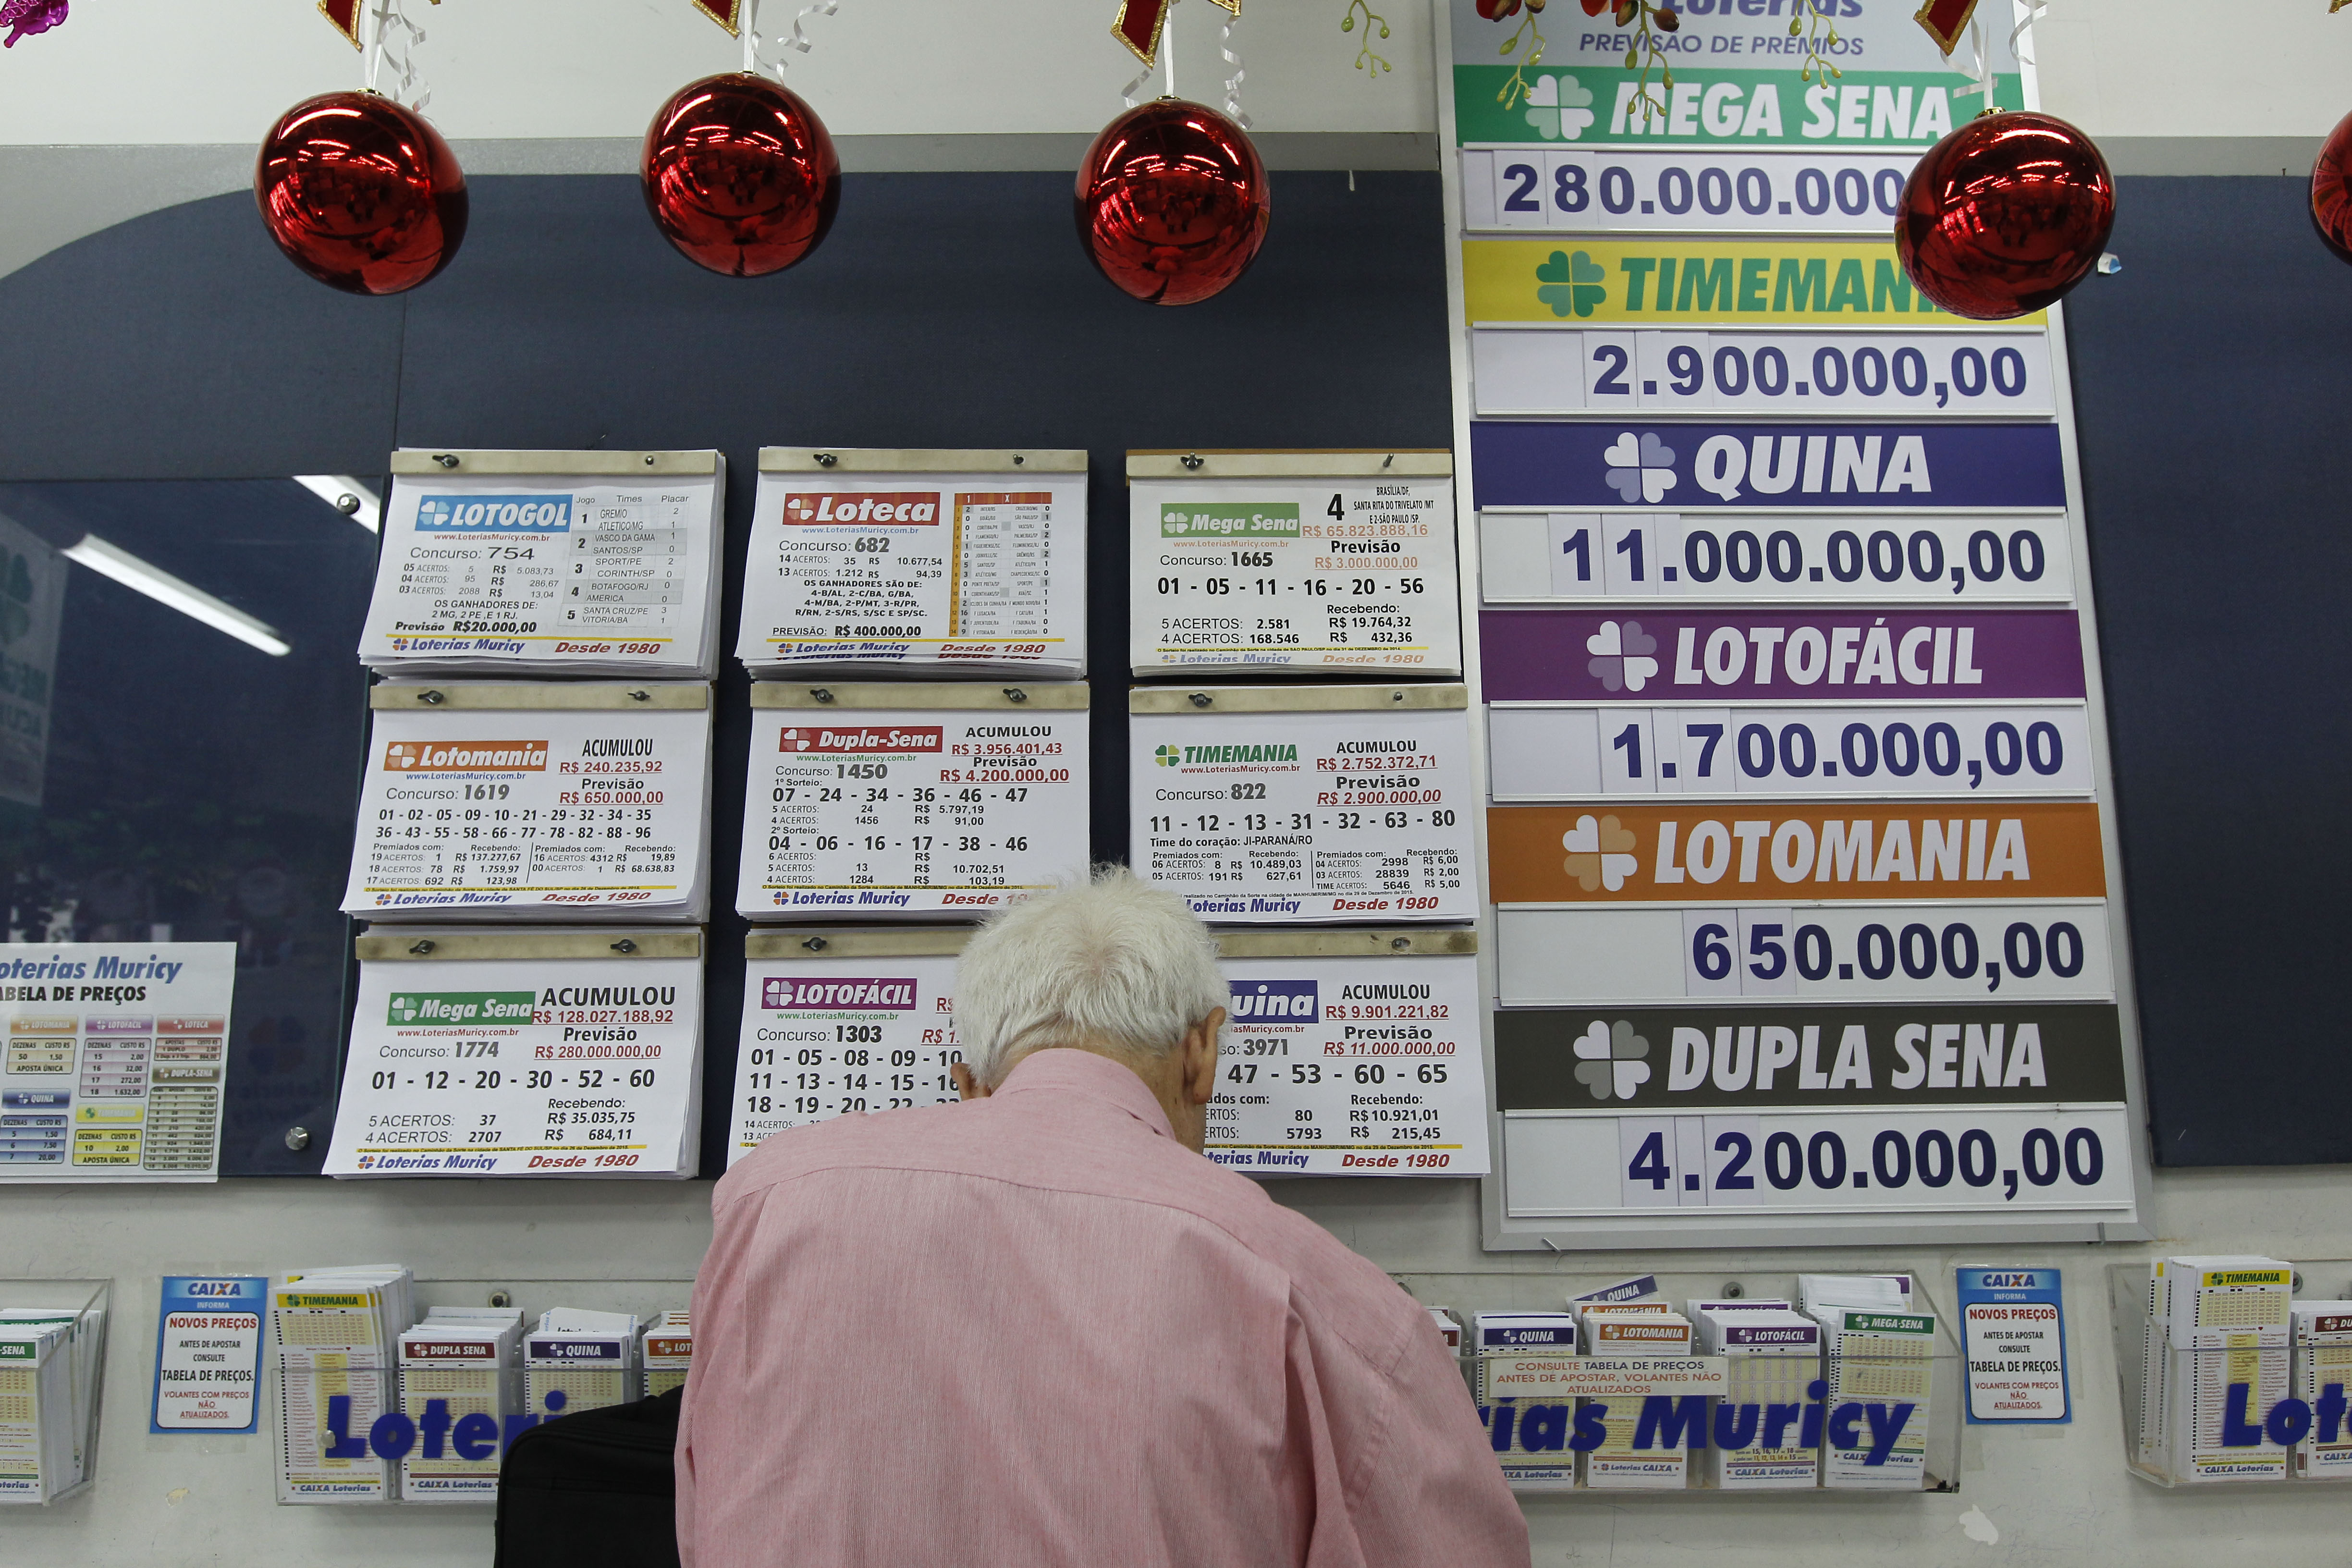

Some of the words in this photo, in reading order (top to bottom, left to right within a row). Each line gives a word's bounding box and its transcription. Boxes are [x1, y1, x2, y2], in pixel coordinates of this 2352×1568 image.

[1580, 30, 1702, 54] PREVISÃO
[1710, 36, 1743, 53] DE
[1609, 82, 1784, 136] MEGA
[1801, 85, 1951, 139] SENA
[1593, 345, 2026, 408] 2.900.000,00
[1695, 435, 1932, 502] QUINA
[451, 503, 567, 526] LOTOGOL
[600, 509, 627, 518] GREMIO
[816, 497, 935, 521] Loteca
[1191, 514, 1245, 533] Mega
[1251, 514, 1298, 530] Sena
[435, 534, 550, 542] www.LoteriasMuricy.com.br
[780, 540, 850, 551] Concurso:
[855, 538, 890, 552] 682
[1174, 540, 1288, 548] www.LoteriasMuricy.com.br
[1332, 539, 1400, 553] Previsão
[411, 548, 481, 558] Concurso:
[489, 547, 534, 560] 754
[1161, 555, 1226, 565] Concurso:
[1232, 552, 1273, 566] 1665
[1563, 528, 2045, 594] 11.000.000,00
[395, 622, 444, 630] Previsão
[453, 621, 537, 633] R$20.000,00
[773, 625, 827, 635] PREVISÃO:
[835, 625, 850, 635] R$
[854, 625, 921, 637] 400.000,00
[411, 638, 470, 650] Loterias
[473, 638, 526, 653] Muricy
[554, 642, 611, 653] Desde
[617, 642, 661, 654] 1980
[1674, 618, 1982, 685] LOTOFÁCIL
[966, 726, 1051, 737] ACUMULOU
[819, 730, 937, 749] Dupla-Sena
[1337, 740, 1416, 753] ACUMULOU
[582, 739, 652, 756] ACUMULOU
[1185, 745, 1297, 763] TIMEMANIA
[420, 743, 547, 767] Lotomania
[974, 756, 1037, 767] Previsão
[1614, 722, 2063, 790] 1.700.000,00
[1181, 764, 1300, 773] www.LoteriasMuricy.com.br
[582, 779, 644, 789] Previsão
[1337, 775, 1420, 788] Previsão
[387, 788, 458, 799] Concurso:
[466, 784, 509, 800] 1619
[560, 792, 579, 804] R$
[585, 791, 663, 804] 650.000,00
[1156, 789, 1227, 800] Concurso:
[1231, 784, 1265, 799] 822
[1151, 838, 1175, 846] Time
[1179, 837, 1192, 846] do
[1196, 837, 1240, 848] coração:
[1244, 835, 1312, 845] JI-PARANÁ/RO
[1654, 819, 2030, 884] LOTOMANIA
[1693, 921, 2083, 992] 650.000,00
[0, 955, 86, 979] oterias
[93, 955, 183, 984] Muricy
[0, 987, 46, 1001] BELA
[53, 987, 74, 1001] DE
[80, 986, 146, 1005] PREÇOS
[541, 987, 675, 1006] ACUMULOU
[795, 980, 911, 1004] LOTOFÁCIL
[1342, 984, 1429, 999] ACUMULOU
[1232, 984, 1314, 1017] uina
[419, 1000, 478, 1021] Mega
[482, 1000, 532, 1017] Sena
[777, 1012, 898, 1022] www.LoteriasMuricy.com.br
[1326, 1005, 1346, 1019] R$
[1352, 1005, 1448, 1019] 9.901.221,82
[564, 1027, 637, 1041] Previsão
[758, 1029, 830, 1041] Concurso:
[837, 1026, 882, 1042] 1303
[1345, 1025, 1432, 1039] Previsão
[535, 1045, 553, 1059] R$
[558, 1045, 661, 1059] 280.000.000,00
[1244, 1039, 1287, 1055] 3971
[1667, 1025, 1872, 1091] DUPLA
[1891, 1023, 2046, 1089] SENA
[1342, 1154, 1398, 1167] Desde
[1407, 1154, 1449, 1167] 1980
[1629, 1127, 2103, 1201] 4.200.000,00
[1983, 1274, 2035, 1286] CAIXA
[2227, 1273, 2279, 1283] TIMEMANIA
[188, 1283, 241, 1296] CAIXA
[1607, 1284, 1641, 1302] QUINA
[303, 1297, 358, 1305] TIMEMANIA
[1970, 1309, 2008, 1319] NOVOS
[2011, 1308, 2057, 1322] PREÇOS
[170, 1318, 208, 1328] NOVOS
[212, 1318, 257, 1331] PREÇOS
[1871, 1318, 1923, 1329] MEGA-SENA
[1519, 1331, 1554, 1343] QUINA
[1623, 1328, 1682, 1338] LOTOMANIA
[1755, 1331, 1804, 1341] LOTOFÁCIL
[430, 1346, 460, 1354] DUPLA
[463, 1346, 486, 1354] SENA
[566, 1345, 601, 1357] QUINA
[1516, 1362, 1580, 1371] CONSULTE
[1654, 1361, 1703, 1372] PREÇOS
[1970, 1361, 2005, 1372] TABELA
[2008, 1361, 2020, 1372] DE
[2023, 1359, 2061, 1374] PREÇOS.
[162, 1370, 196, 1381] TABELA
[200, 1371, 212, 1381] DE
[215, 1371, 255, 1384] PREÇOS.
[1560, 1374, 1619, 1382] APOSTAR,
[1693, 1372, 1721, 1381] NÃO
[1633, 1380, 1914, 1466] Muricy
[2204, 1464, 2233, 1473] CAIXA
